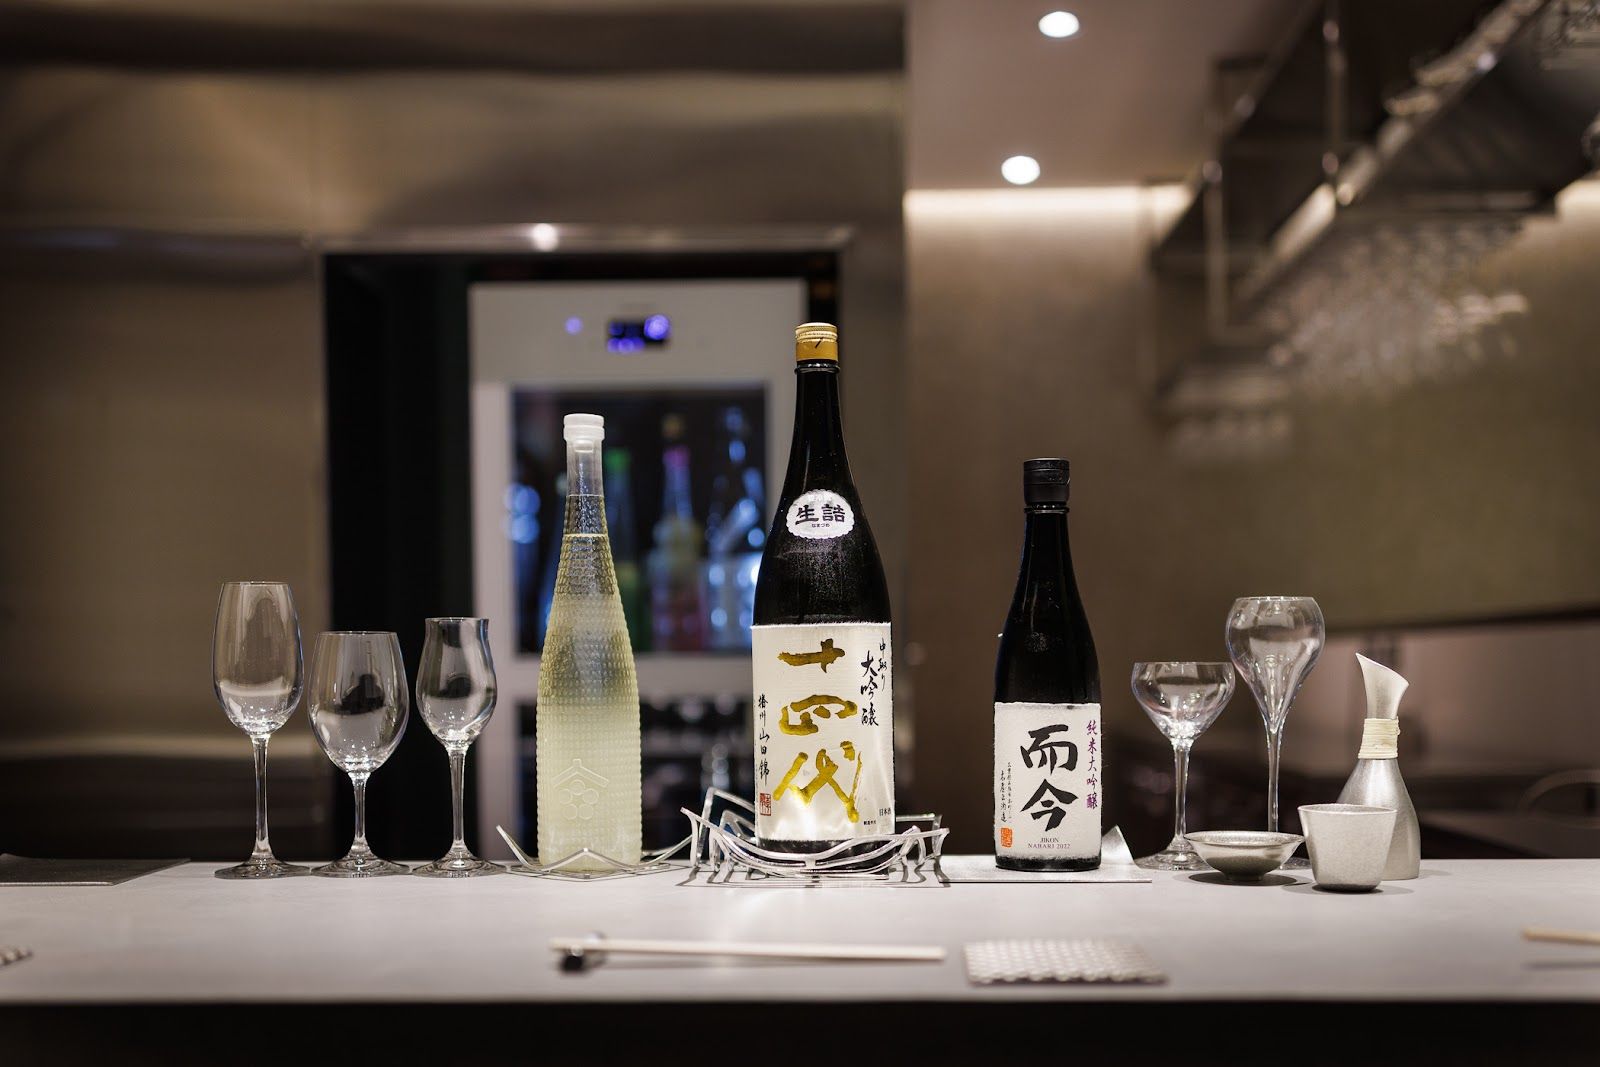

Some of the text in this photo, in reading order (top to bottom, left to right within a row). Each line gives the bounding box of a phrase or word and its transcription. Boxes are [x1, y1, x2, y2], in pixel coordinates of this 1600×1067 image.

[795, 503, 846, 526] 生詰
[773, 638, 862, 823] 十四代
[1019, 723, 1079, 832] 而今
